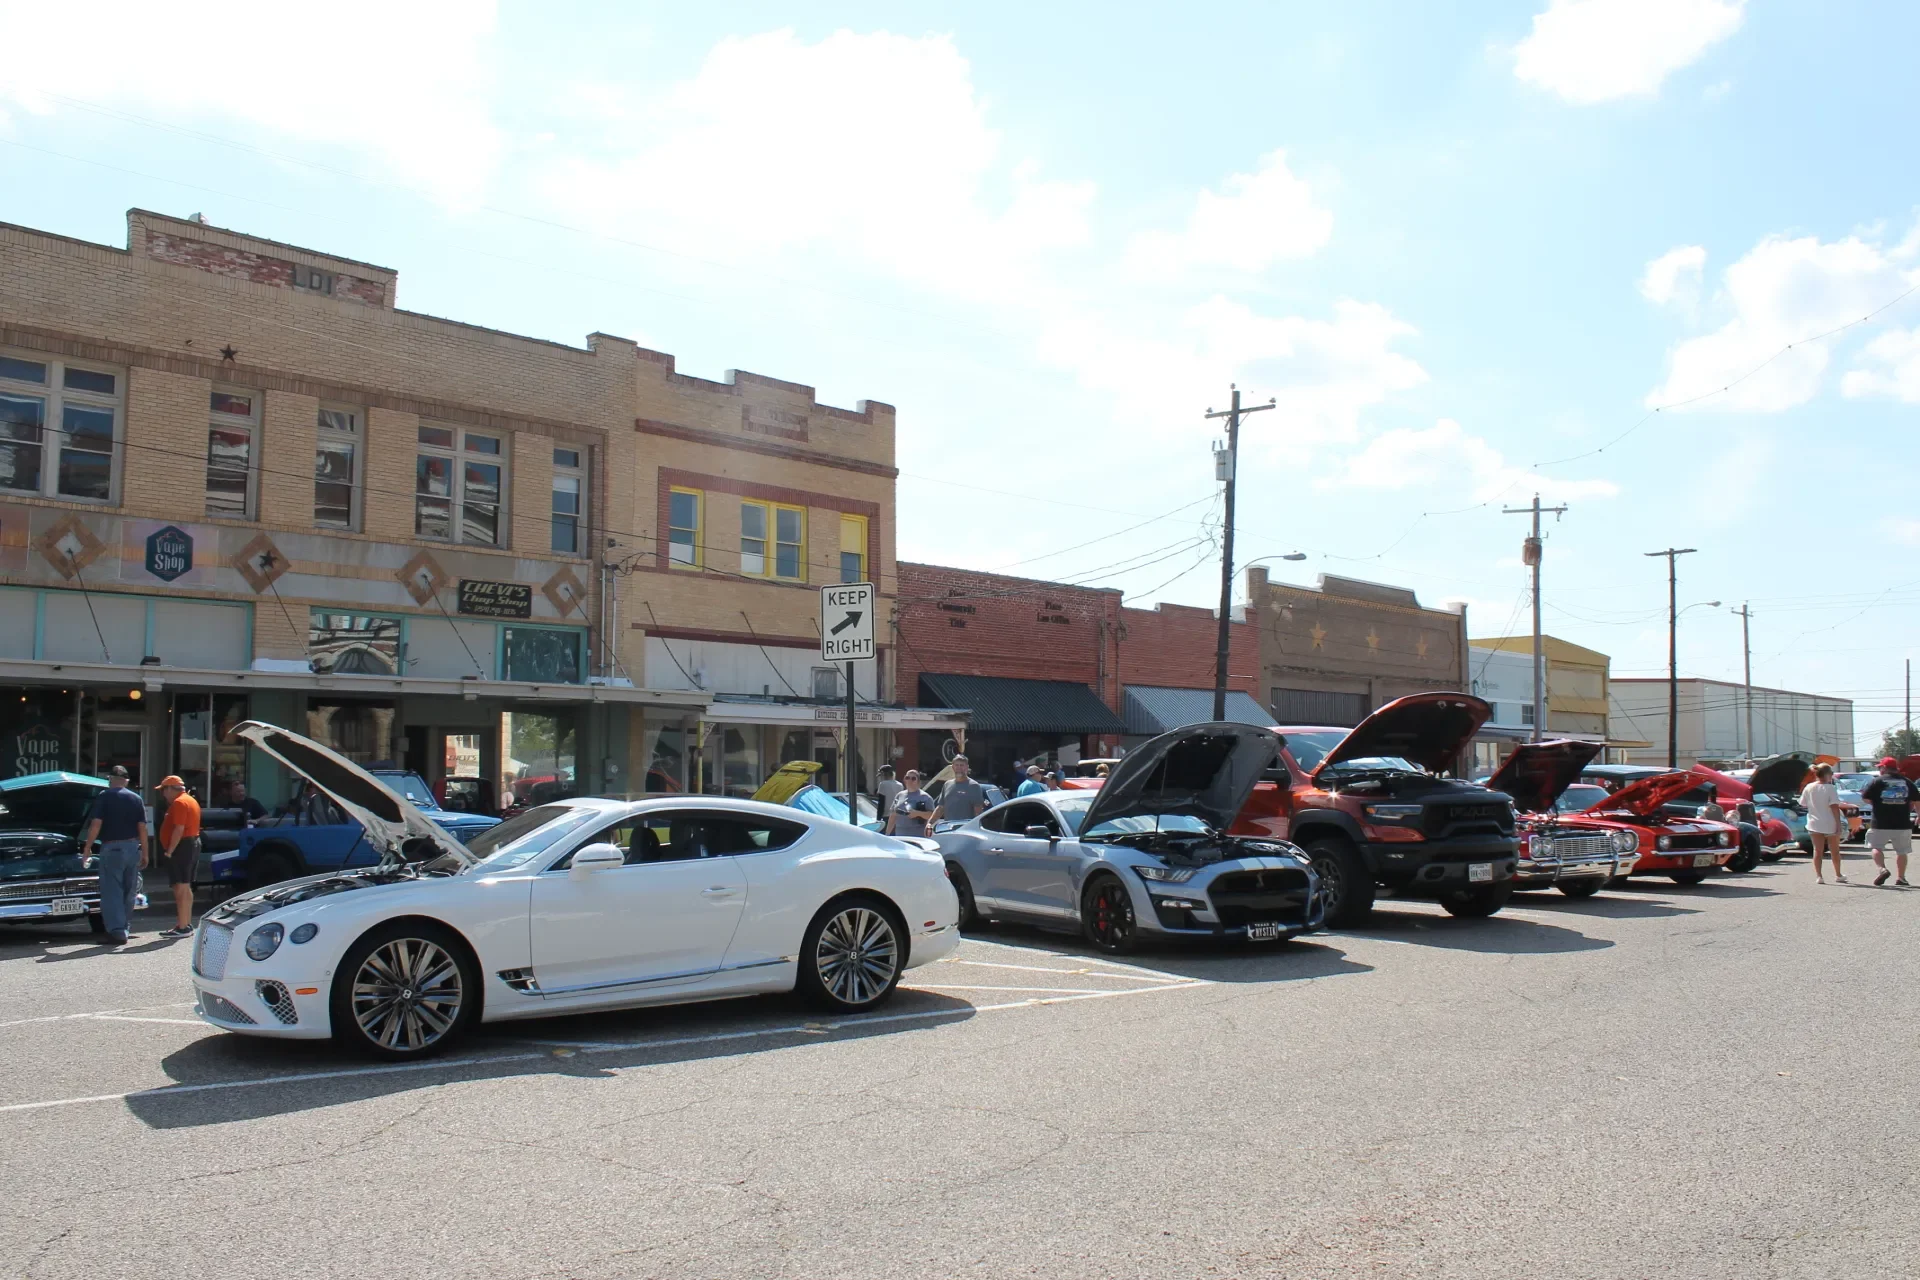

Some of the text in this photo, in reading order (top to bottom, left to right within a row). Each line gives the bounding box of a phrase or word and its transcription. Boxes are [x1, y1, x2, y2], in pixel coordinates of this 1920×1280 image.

[155, 537, 185, 556] Vape
[154, 553, 185, 573] Shop
[463, 581, 529, 597] CHEVI'S
[462, 592, 496, 605] Chop
[495, 595, 529, 608] Shop
[828, 590, 868, 606] KEEP
[825, 638, 871, 654] RIGHT
[16, 735, 60, 758] Vape
